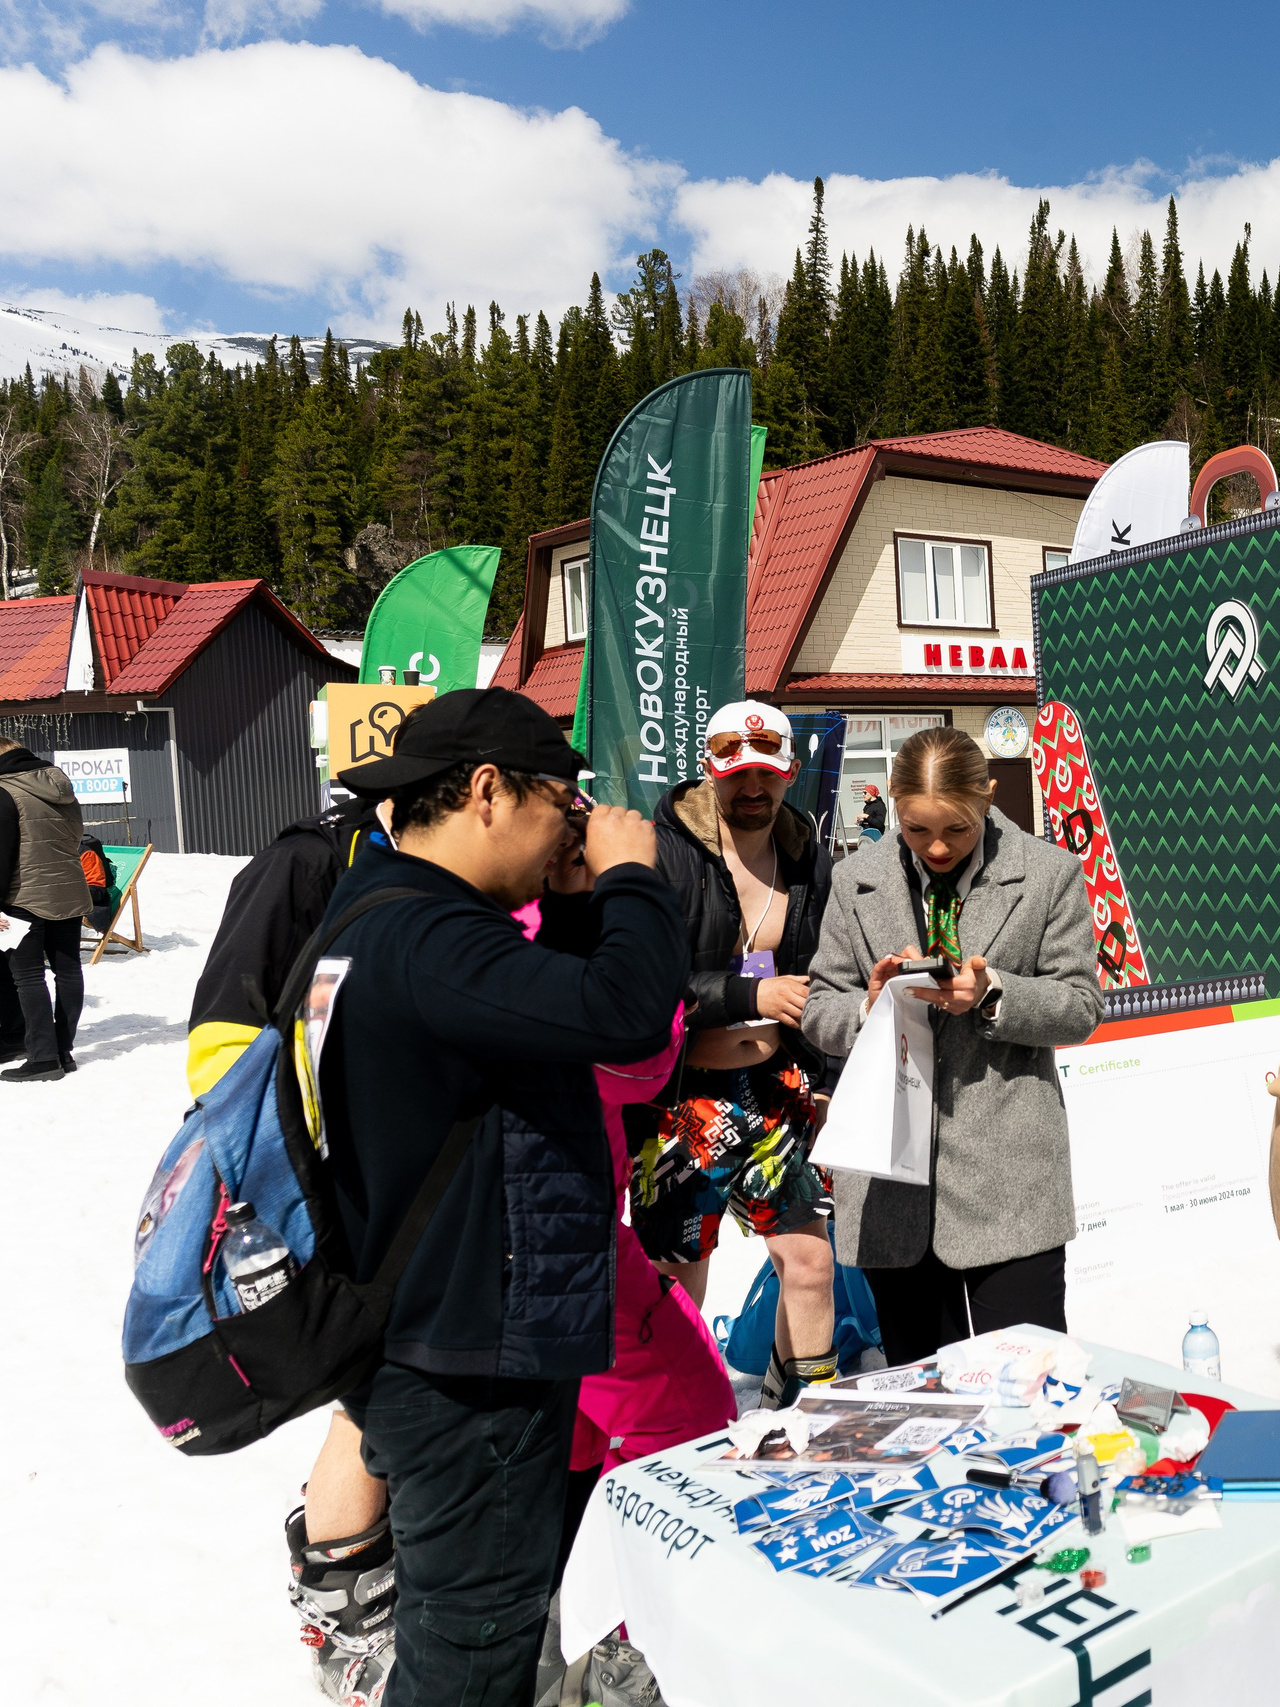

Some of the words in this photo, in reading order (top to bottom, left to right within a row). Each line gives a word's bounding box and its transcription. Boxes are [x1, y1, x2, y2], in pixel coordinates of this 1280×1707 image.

[634, 452, 677, 784] НОВОКУЗНЕЦК
[923, 643, 1035, 669] НЕВАЛ
[695, 685, 711, 781] эропорт
[60, 758, 122, 776] ПРОКАТ
[1079, 1058, 1141, 1076] Certificate
[1161, 1184, 1174, 1192] The
[1175, 1180, 1192, 1189] offer
[1200, 1174, 1216, 1183] valid
[1164, 1205, 1169, 1213] 1
[1170, 1203, 1185, 1212] мая
[1189, 1198, 1199, 1208] 30
[1199, 1195, 1218, 1205] июня
[1218, 1190, 1235, 1201] 2024
[1235, 1187, 1251, 1197] года
[1087, 1218, 1107, 1232] дней
[1074, 1260, 1114, 1275] Signature
[606, 1478, 716, 1559] аэропорт
